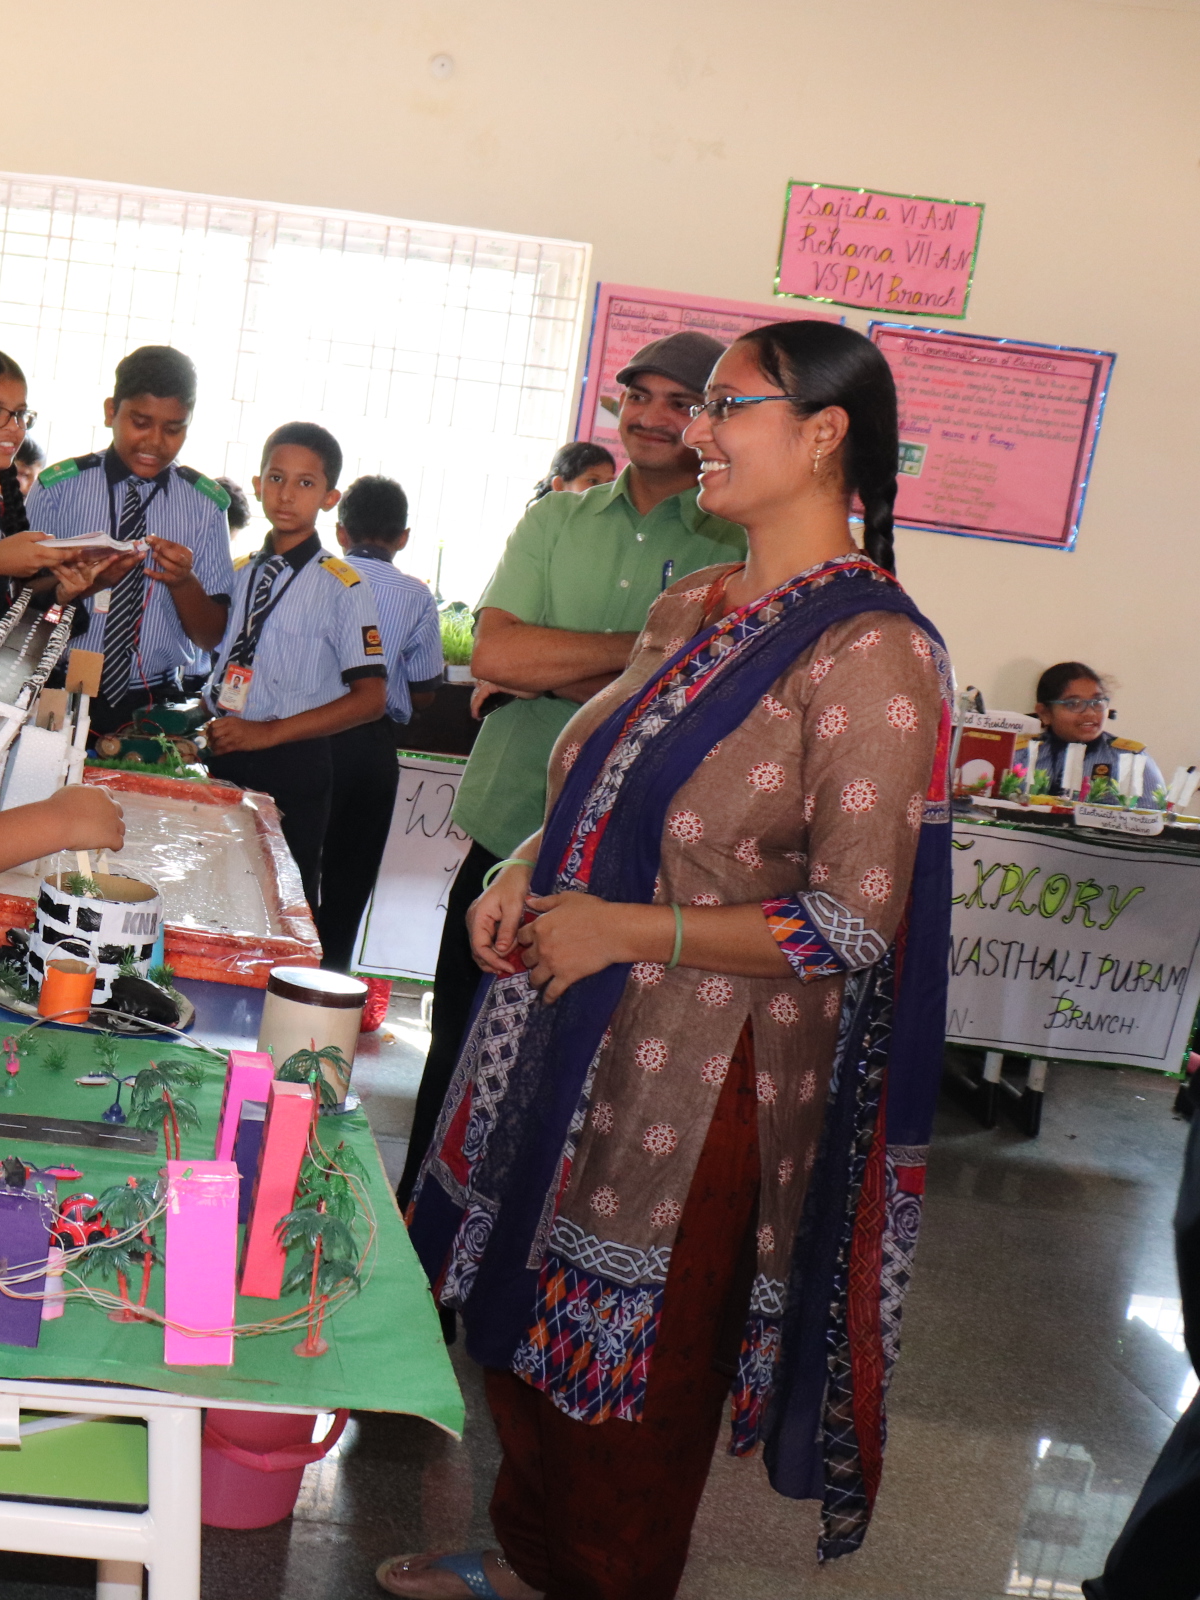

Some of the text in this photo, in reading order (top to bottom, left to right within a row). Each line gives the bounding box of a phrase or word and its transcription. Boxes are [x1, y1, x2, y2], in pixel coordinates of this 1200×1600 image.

[796, 190, 889, 226] Sajida
[798, 222, 895, 263] Rehana
[886, 273, 957, 306] Branch
